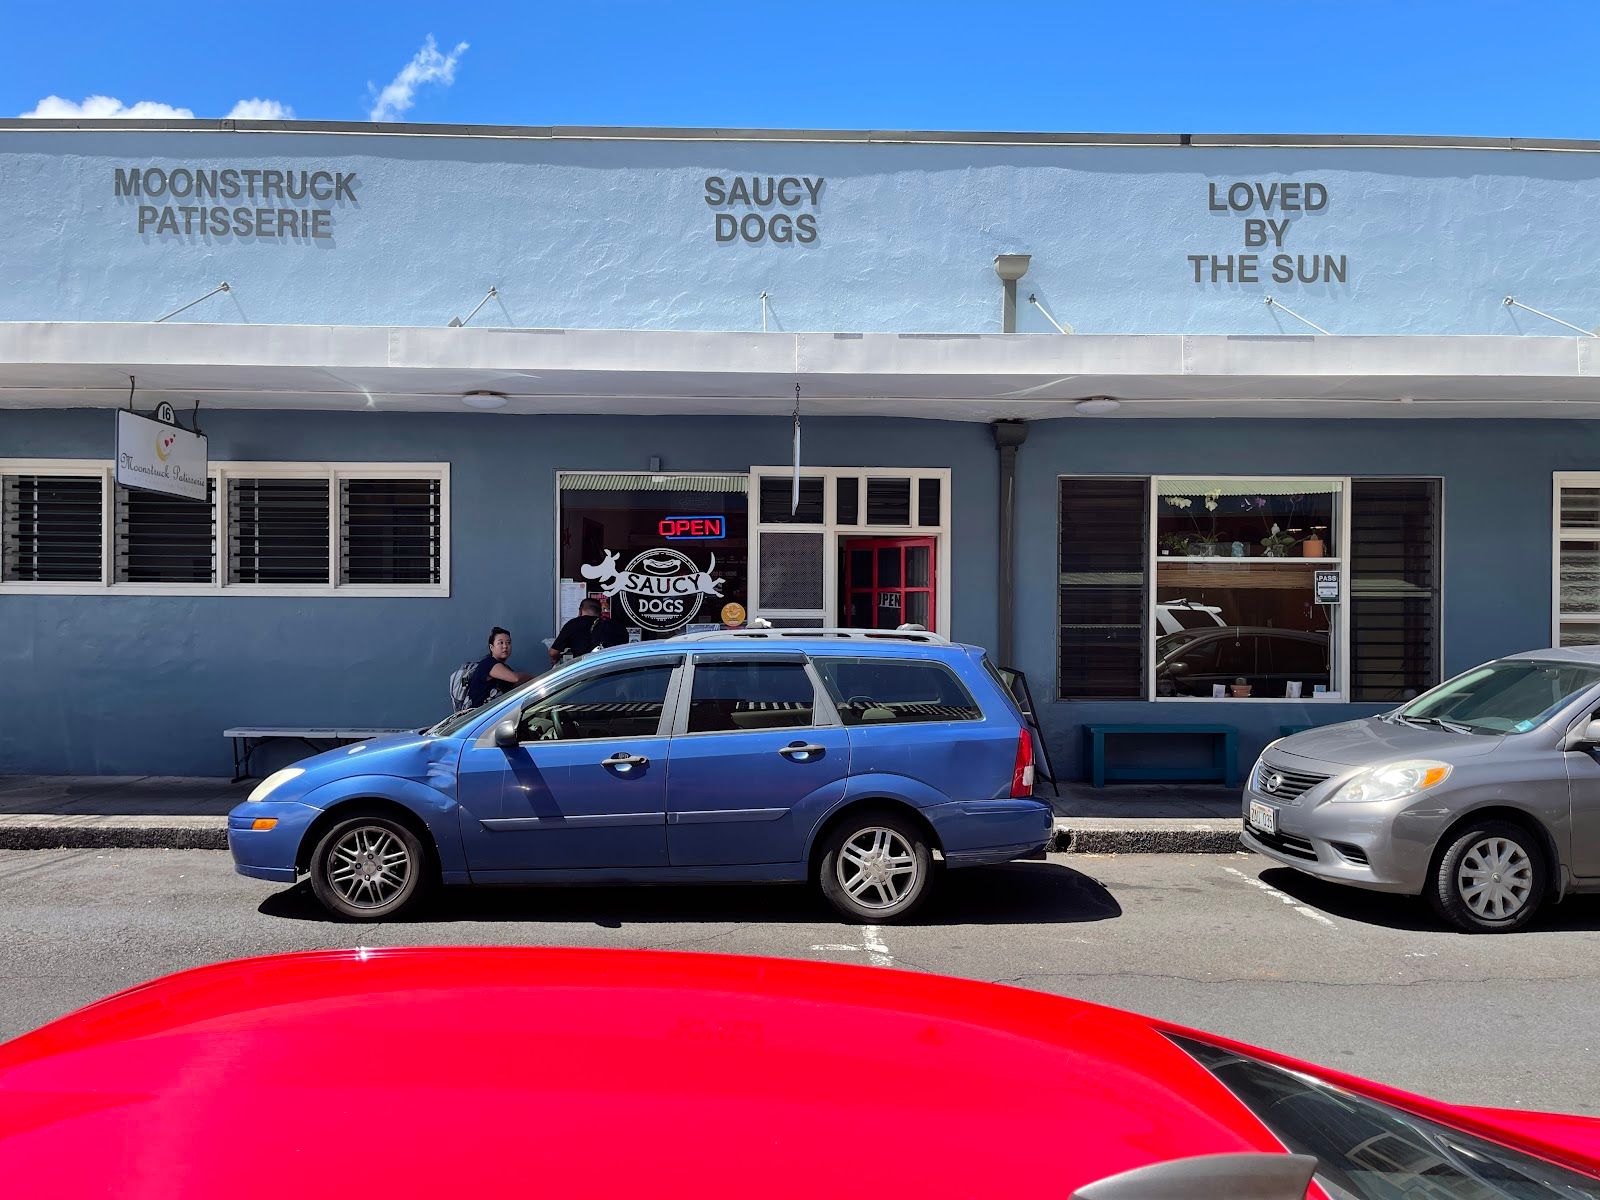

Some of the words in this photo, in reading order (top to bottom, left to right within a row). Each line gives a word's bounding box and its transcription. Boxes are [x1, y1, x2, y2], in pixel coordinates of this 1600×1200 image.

[114, 168, 358, 201] MOONSTRUCK
[704, 176, 825, 206] SAUCY
[1208, 182, 1328, 211] LOVED
[138, 205, 332, 238] PATISSERIE
[715, 213, 817, 243] DOGS
[1245, 219, 1290, 247] BY
[1187, 255, 1259, 283] THE
[1271, 254, 1347, 283] SUN
[162, 406, 171, 420] 16
[120, 452, 170, 479] Moonstruck
[172, 465, 205, 487] Patisserie
[659, 519, 720, 536] OPEN
[625, 573, 700, 594] SAUCY
[638, 598, 684, 613] DOGS
